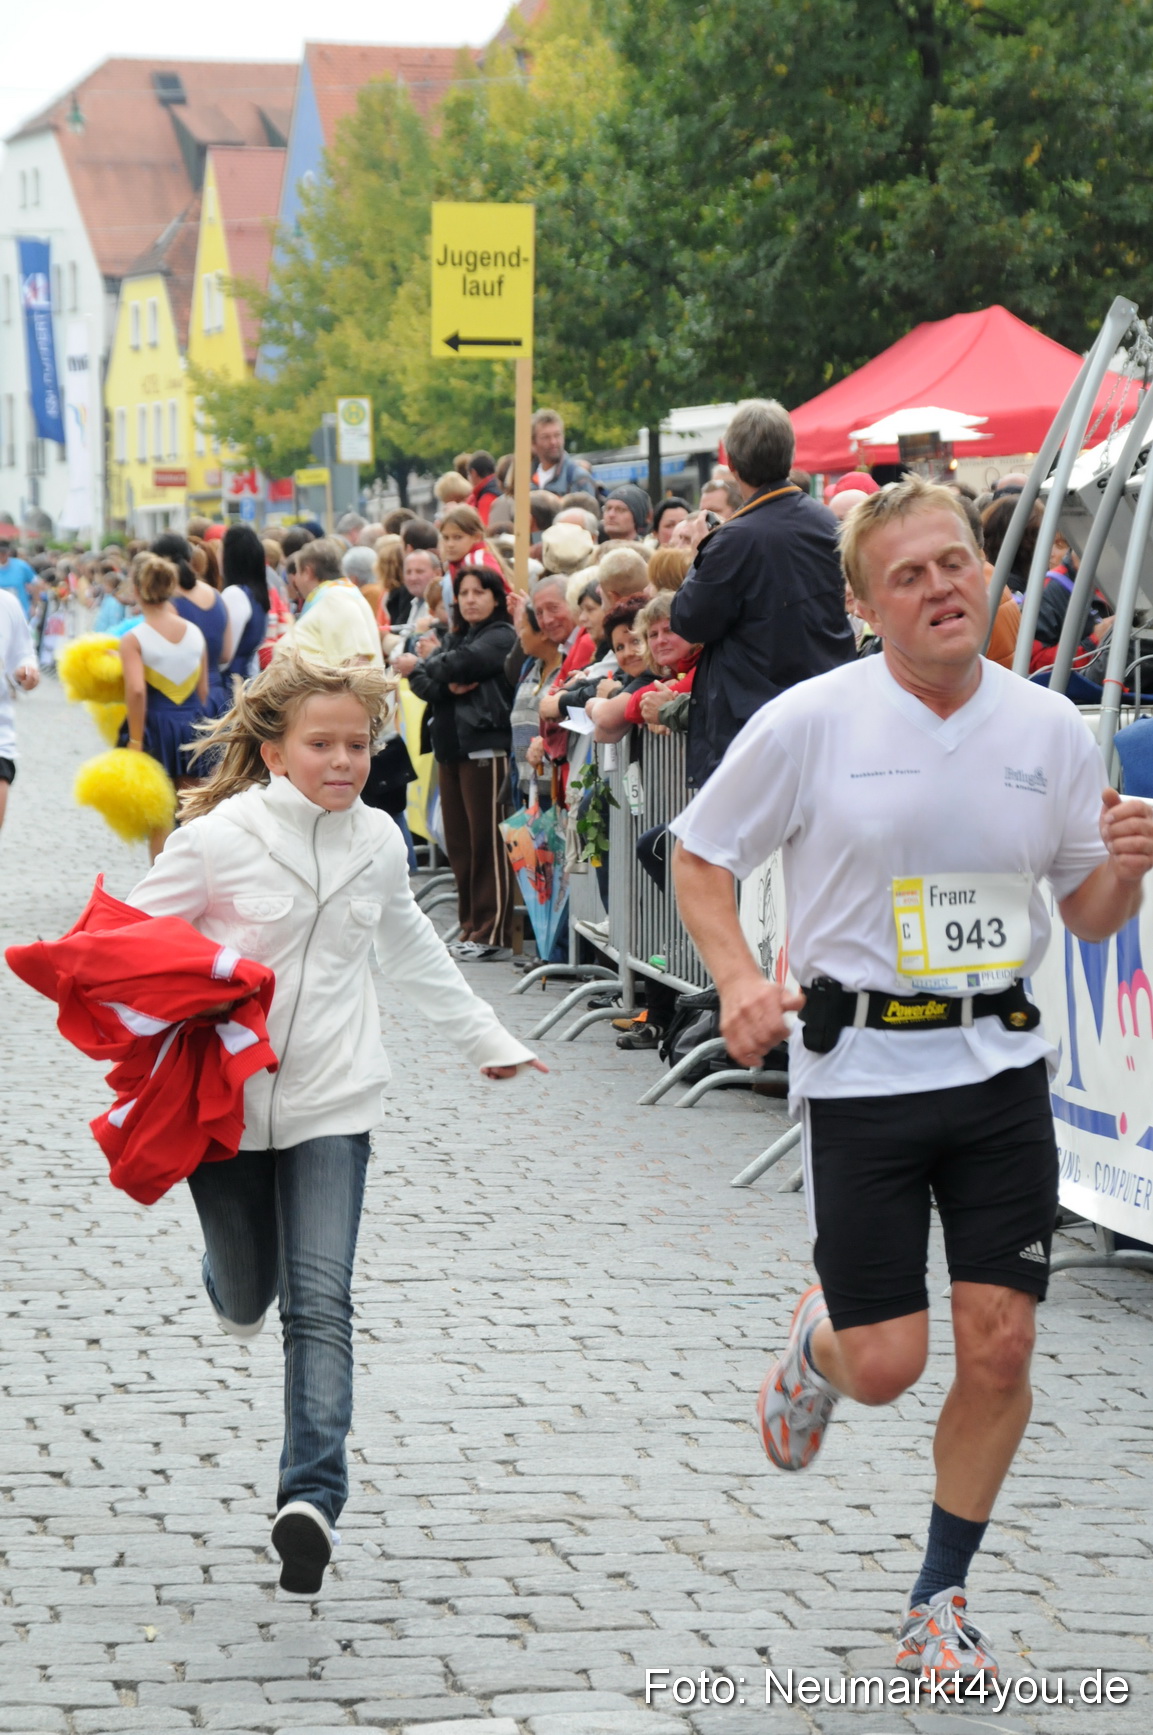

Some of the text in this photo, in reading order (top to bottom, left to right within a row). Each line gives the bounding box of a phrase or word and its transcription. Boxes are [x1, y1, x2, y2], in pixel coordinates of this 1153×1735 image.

[437, 244, 529, 272] Jugend-
[462, 275, 505, 296] lauf
[631, 784, 639, 799] 5
[930, 886, 977, 907] Franz
[902, 922, 911, 940] C
[945, 917, 1007, 952] 943
[886, 1000, 948, 1017] PowerBar
[1095, 1161, 1153, 1211] COMPUTER
